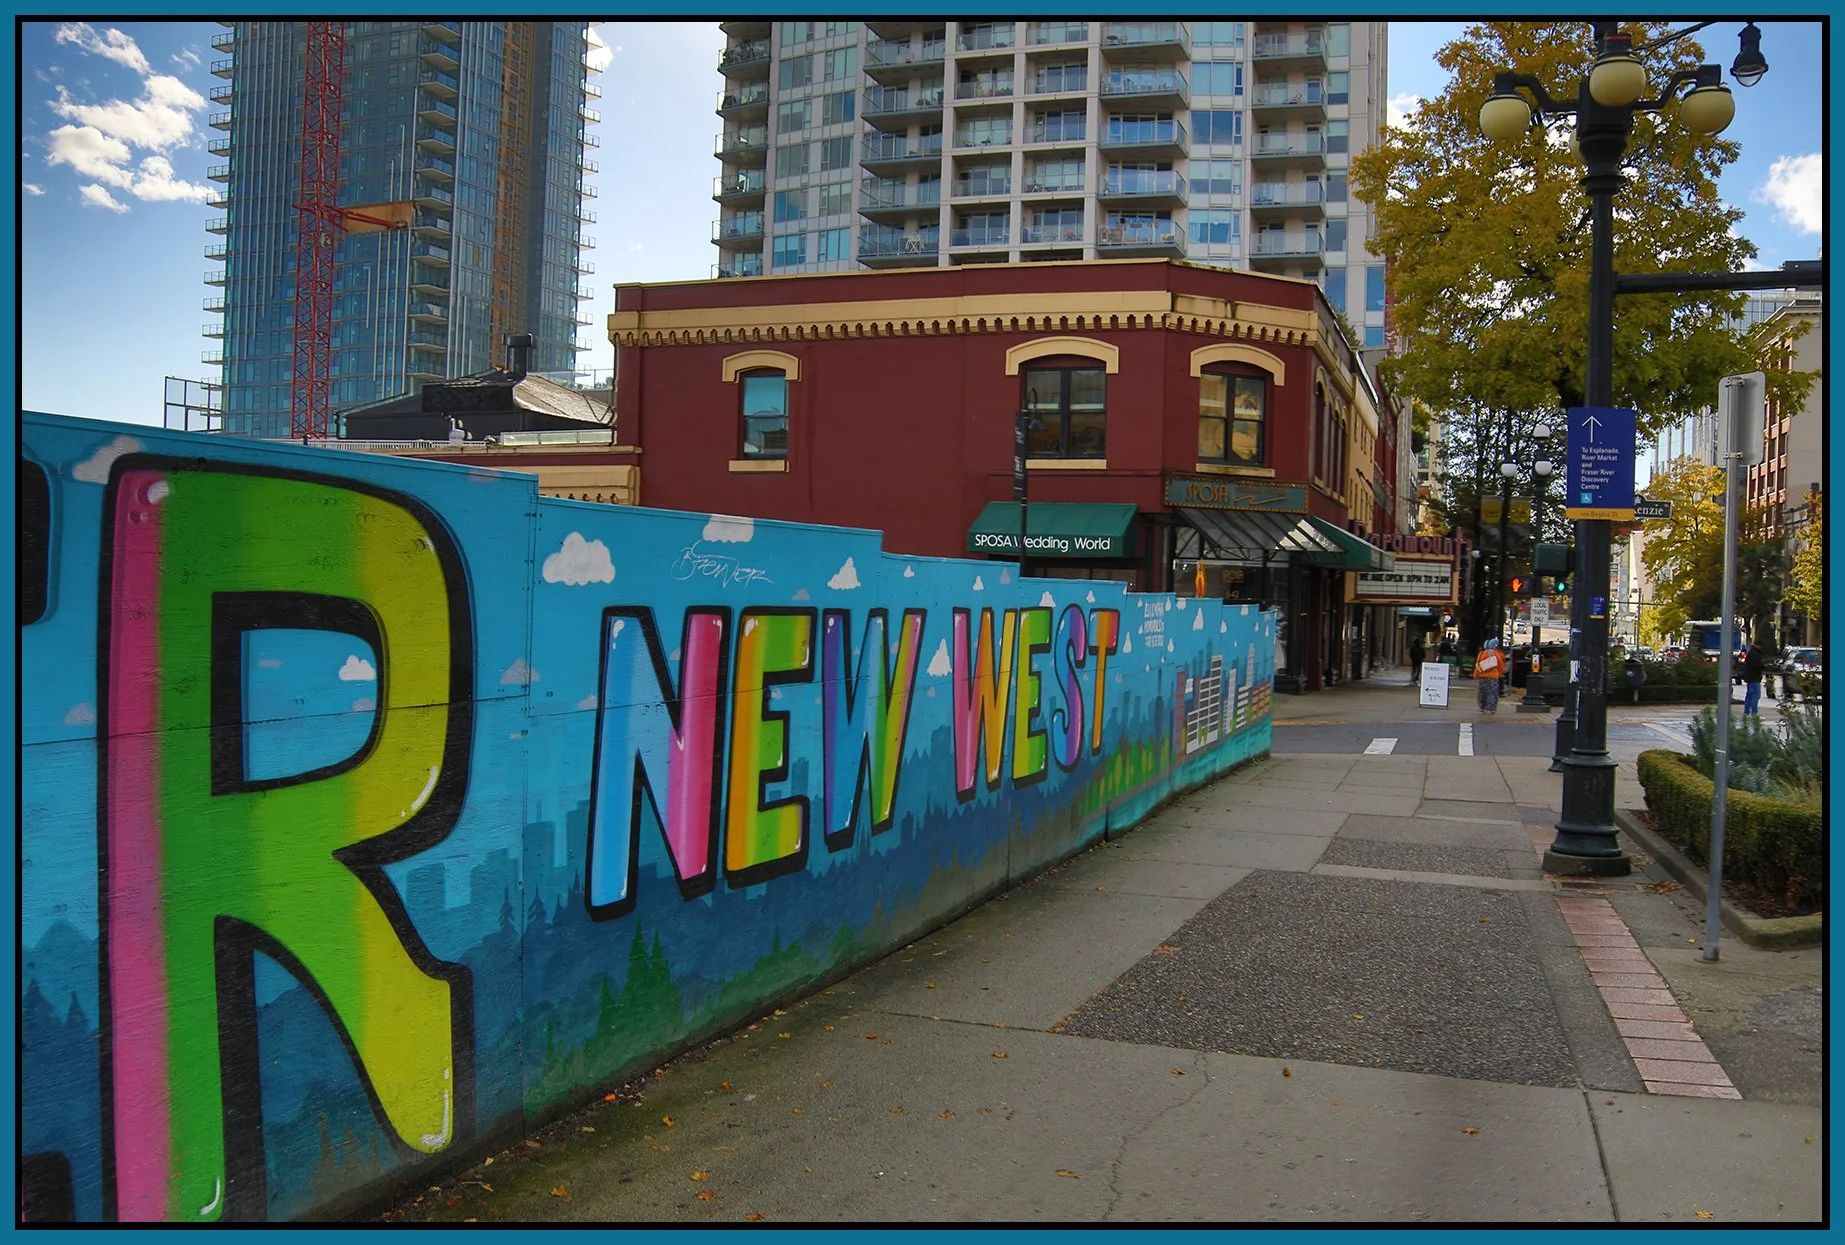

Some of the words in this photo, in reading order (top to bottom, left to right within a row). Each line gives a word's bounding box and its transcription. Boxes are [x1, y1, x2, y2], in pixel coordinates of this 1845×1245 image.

[1581, 476, 1610, 484] Discovery
[1187, 482, 1229, 503] SPOSA
[1637, 503, 1664, 516] enzie
[974, 534, 1013, 547] SPOSA
[1074, 537, 1111, 550] World
[585, 605, 927, 922] NEW
[952, 604, 1119, 800] WEST
